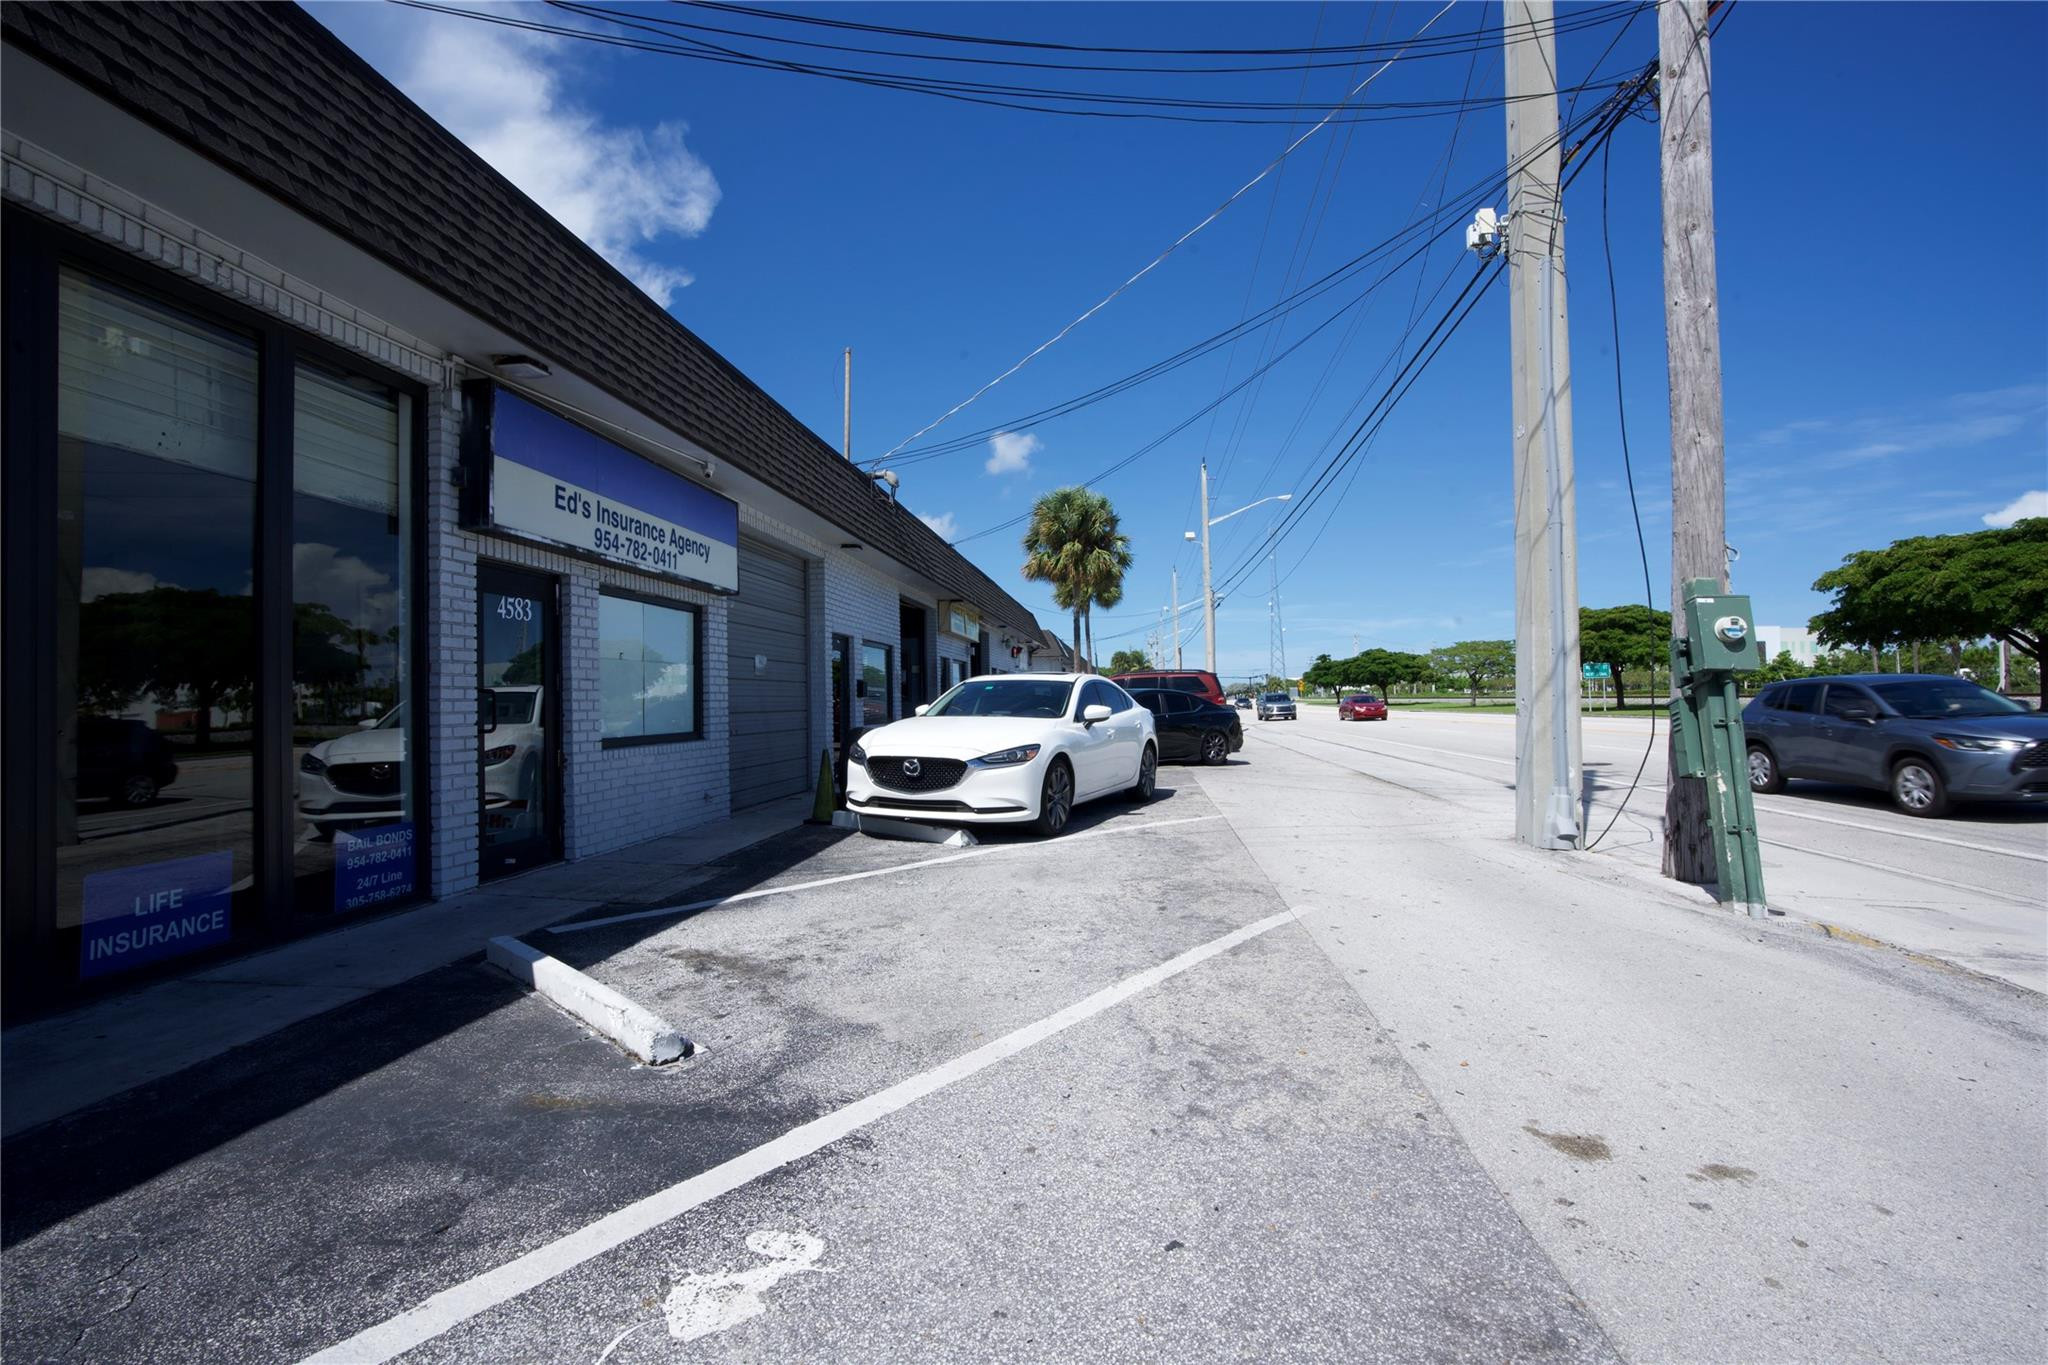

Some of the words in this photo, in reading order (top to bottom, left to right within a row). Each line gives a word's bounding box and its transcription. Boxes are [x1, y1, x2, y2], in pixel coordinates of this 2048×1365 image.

[554, 484, 592, 519] Ed's
[596, 501, 666, 544] Insurance
[669, 528, 711, 563] Agency
[594, 528, 678, 570] 954-782-0411
[496, 595, 532, 622] 4583
[347, 837, 373, 852] BAIL
[376, 829, 413, 846] BONDS
[346, 846, 413, 870] 954-782-0411
[356, 874, 379, 890] 24/7
[381, 871, 403, 884] Line
[134, 888, 184, 917] LIFE
[88, 909, 225, 961] INSURANCE
